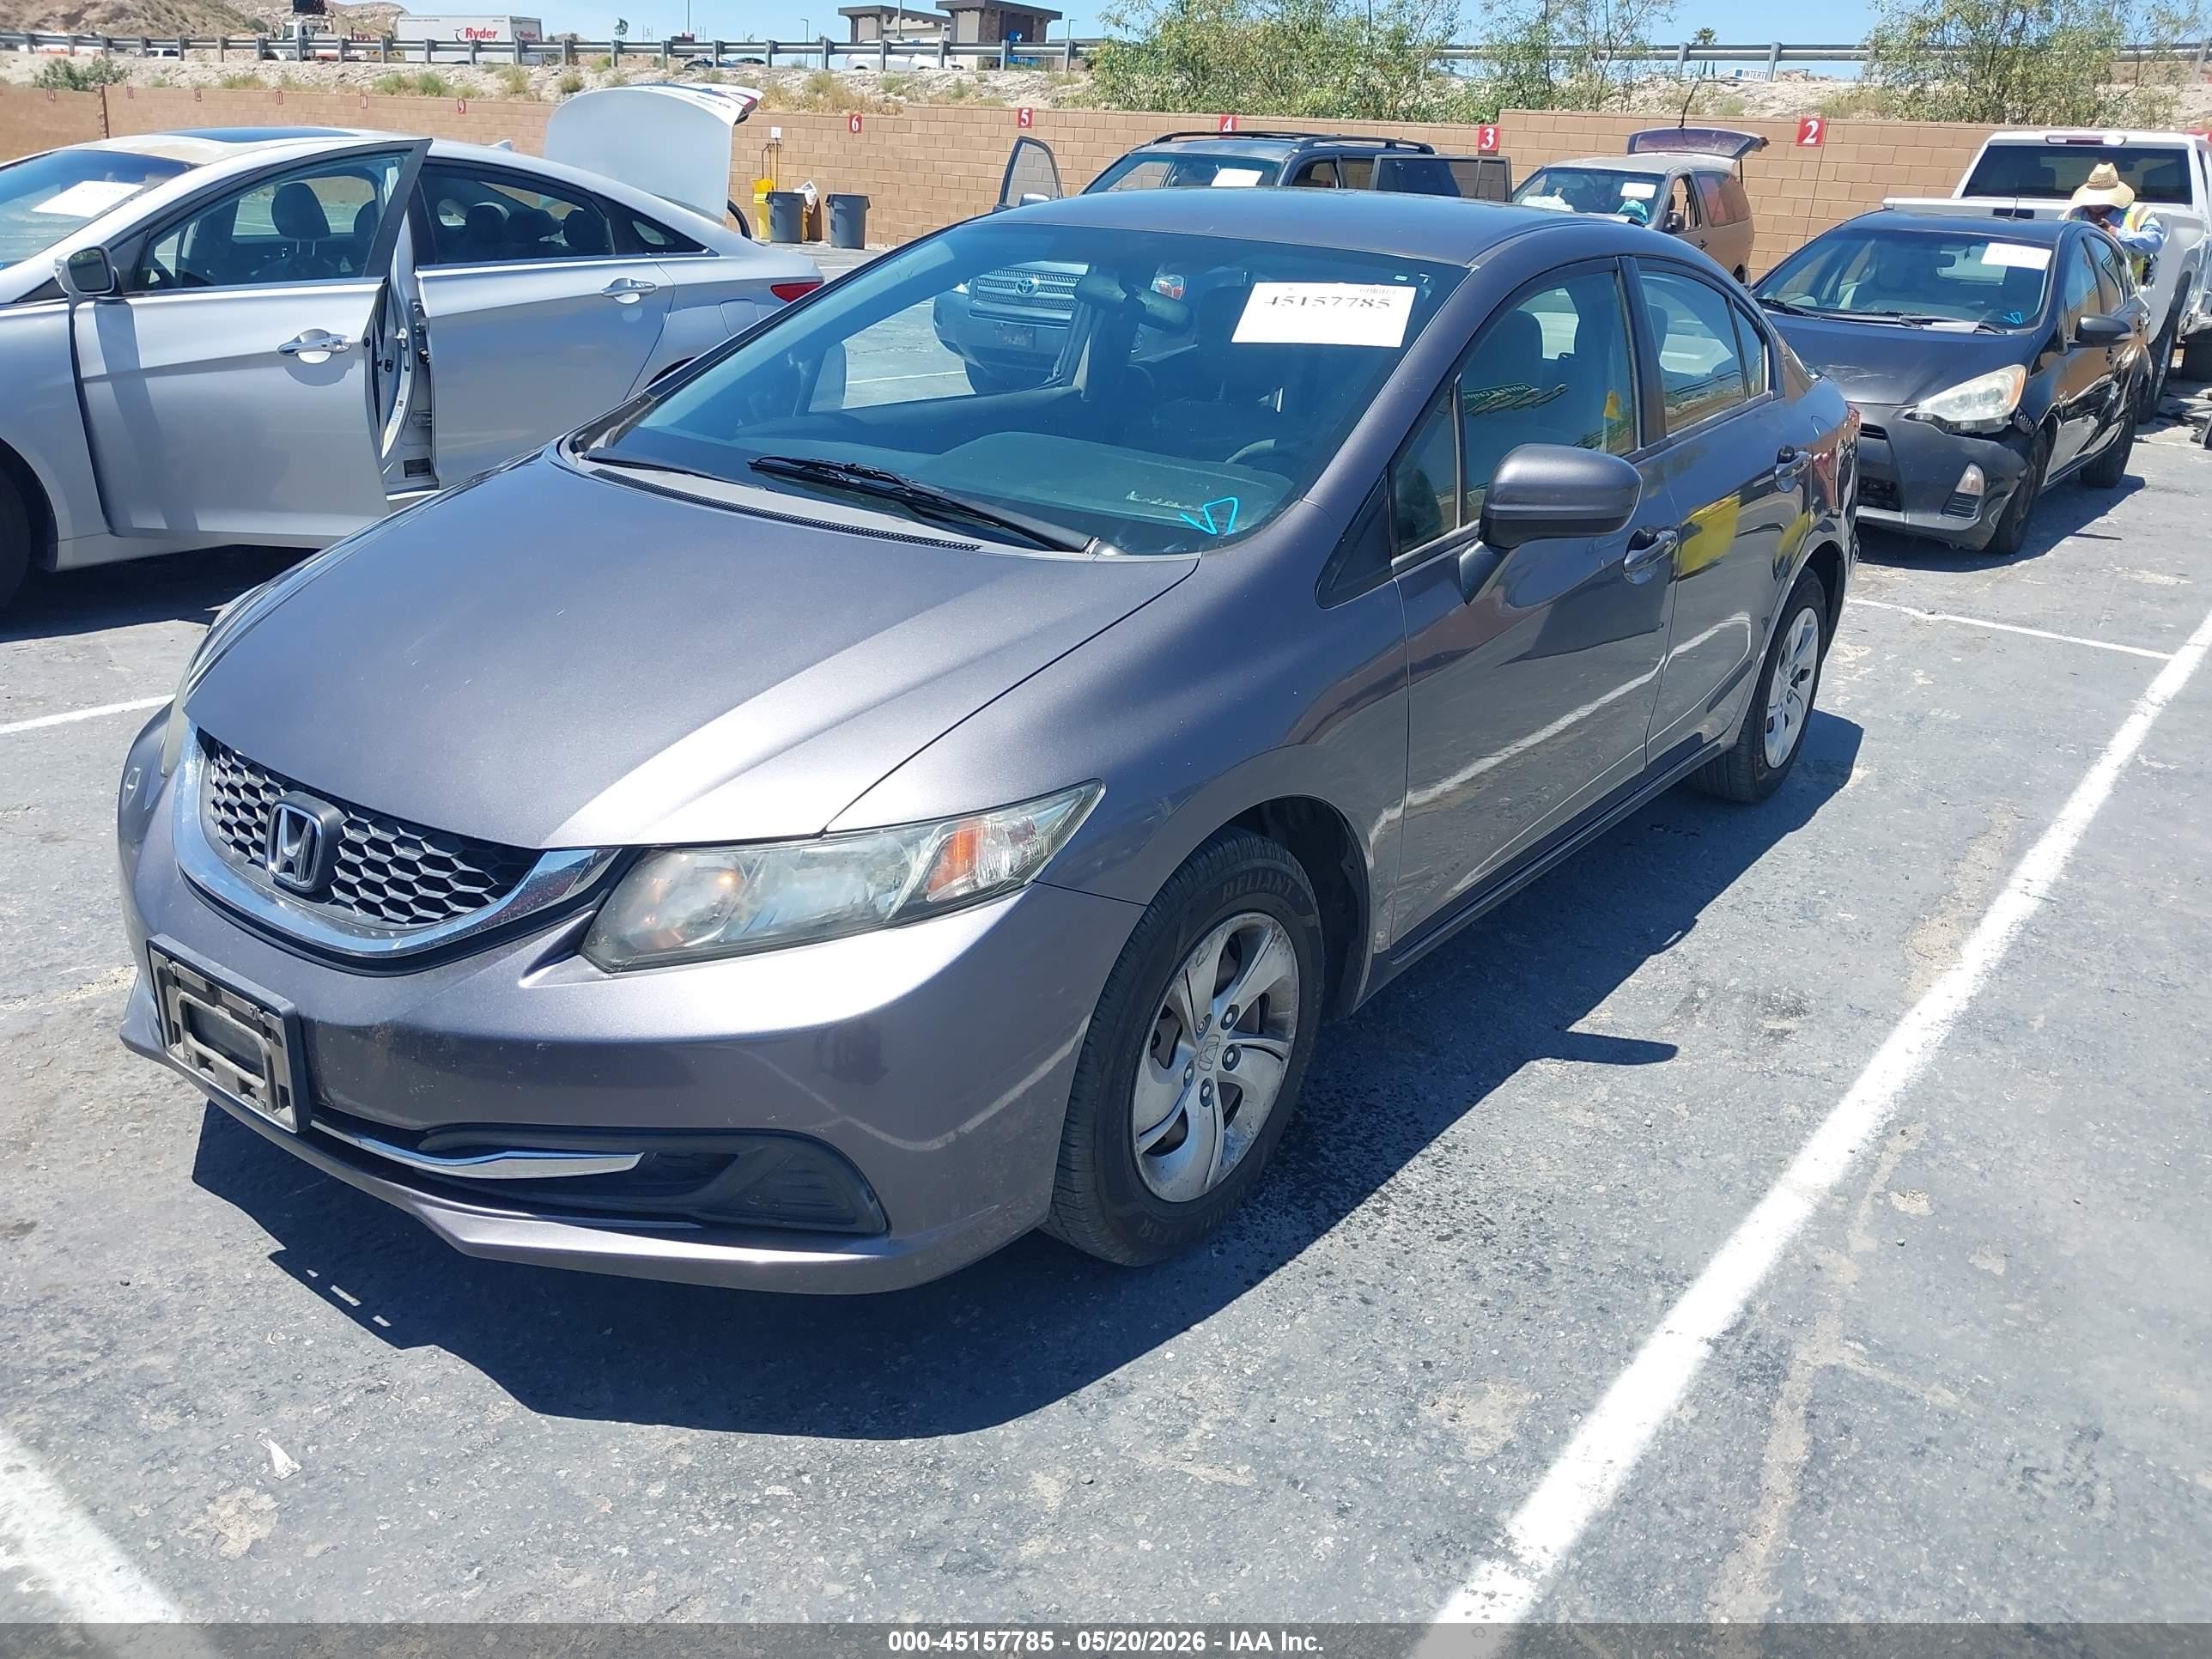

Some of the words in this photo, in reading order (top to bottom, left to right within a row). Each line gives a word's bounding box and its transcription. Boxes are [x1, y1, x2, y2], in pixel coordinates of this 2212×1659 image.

[465, 27, 497, 40] Ryder
[459, 99, 465, 112] 9
[851, 115, 860, 131] 6
[1020, 108, 1030, 126] 5
[1222, 116, 1233, 132] 4
[1480, 127, 1495, 149] 3
[1802, 120, 1819, 144] 2
